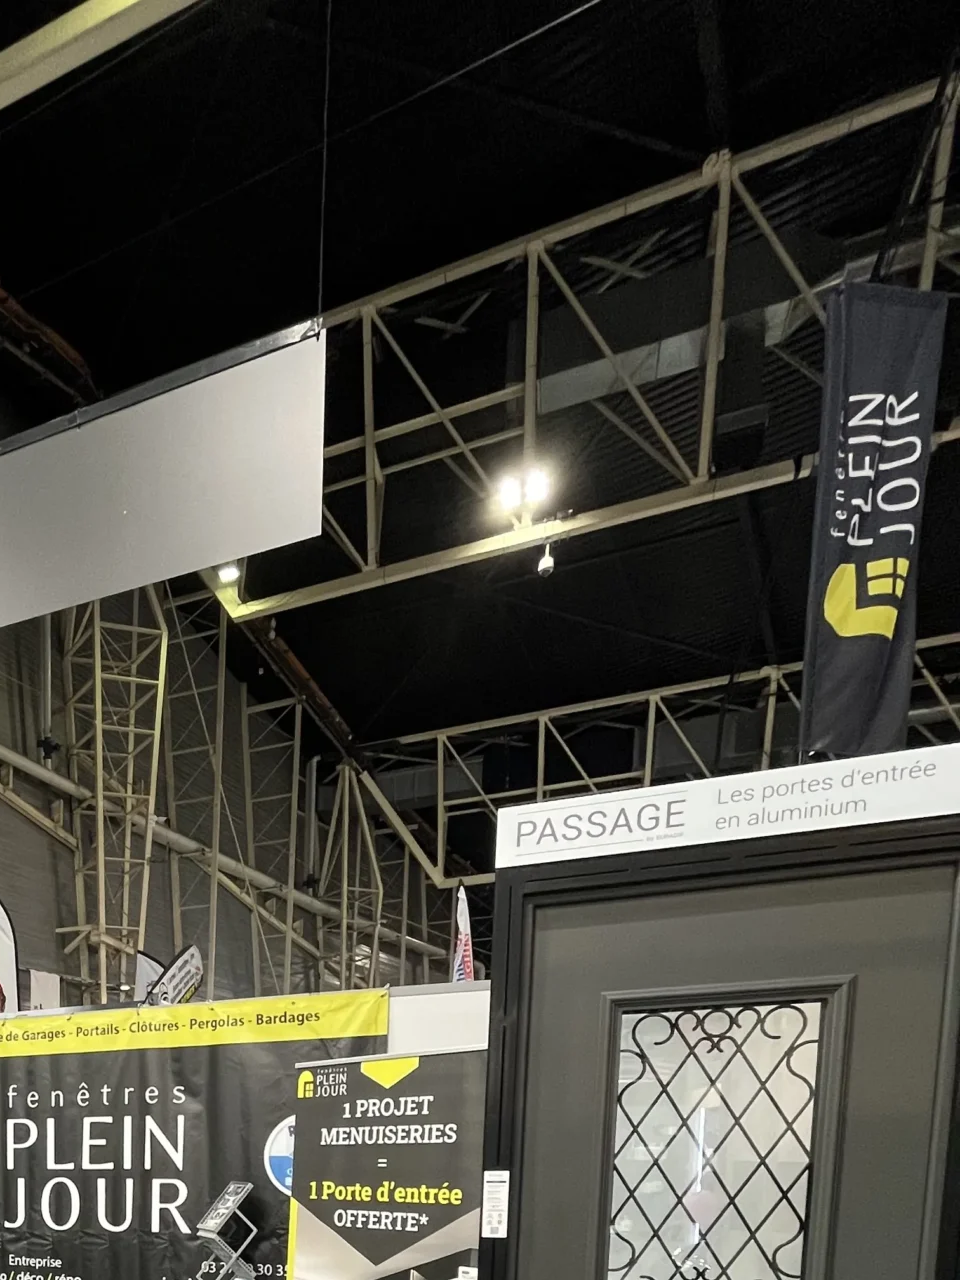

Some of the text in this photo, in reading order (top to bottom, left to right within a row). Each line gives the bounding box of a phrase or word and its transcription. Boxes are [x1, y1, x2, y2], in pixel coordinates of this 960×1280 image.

[847, 393, 885, 546] PLEIN
[876, 391, 922, 545] JOUR
[718, 761, 937, 805] Les portes d'entrée
[516, 799, 686, 847] PASSAGE
[715, 797, 867, 830] en aluminium
[6, 1031, 19, 1042] de
[22, 1029, 66, 1042] Garages
[76, 1024, 119, 1037] Portails
[129, 1020, 179, 1034] Clôtures
[189, 1015, 245, 1031] Pergolas
[256, 1011, 320, 1026] Bardages
[316, 1073, 347, 1086] PLEIN
[316, 1084, 347, 1097] JOUR
[7, 1083, 185, 1109] fenêtres
[343, 1096, 434, 1118] 1 PROJET
[6, 1114, 184, 1172] PLEIN
[320, 1124, 457, 1145] MENUISERIES
[3, 1177, 192, 1235] JOUR
[309, 1181, 318, 1199] 1
[322, 1182, 371, 1202] Porte
[376, 1181, 463, 1205] d'entrée
[9, 1254, 62, 1269] Entreprise
[201, 1261, 216, 1273] 03
[257, 1264, 273, 1276] 30
